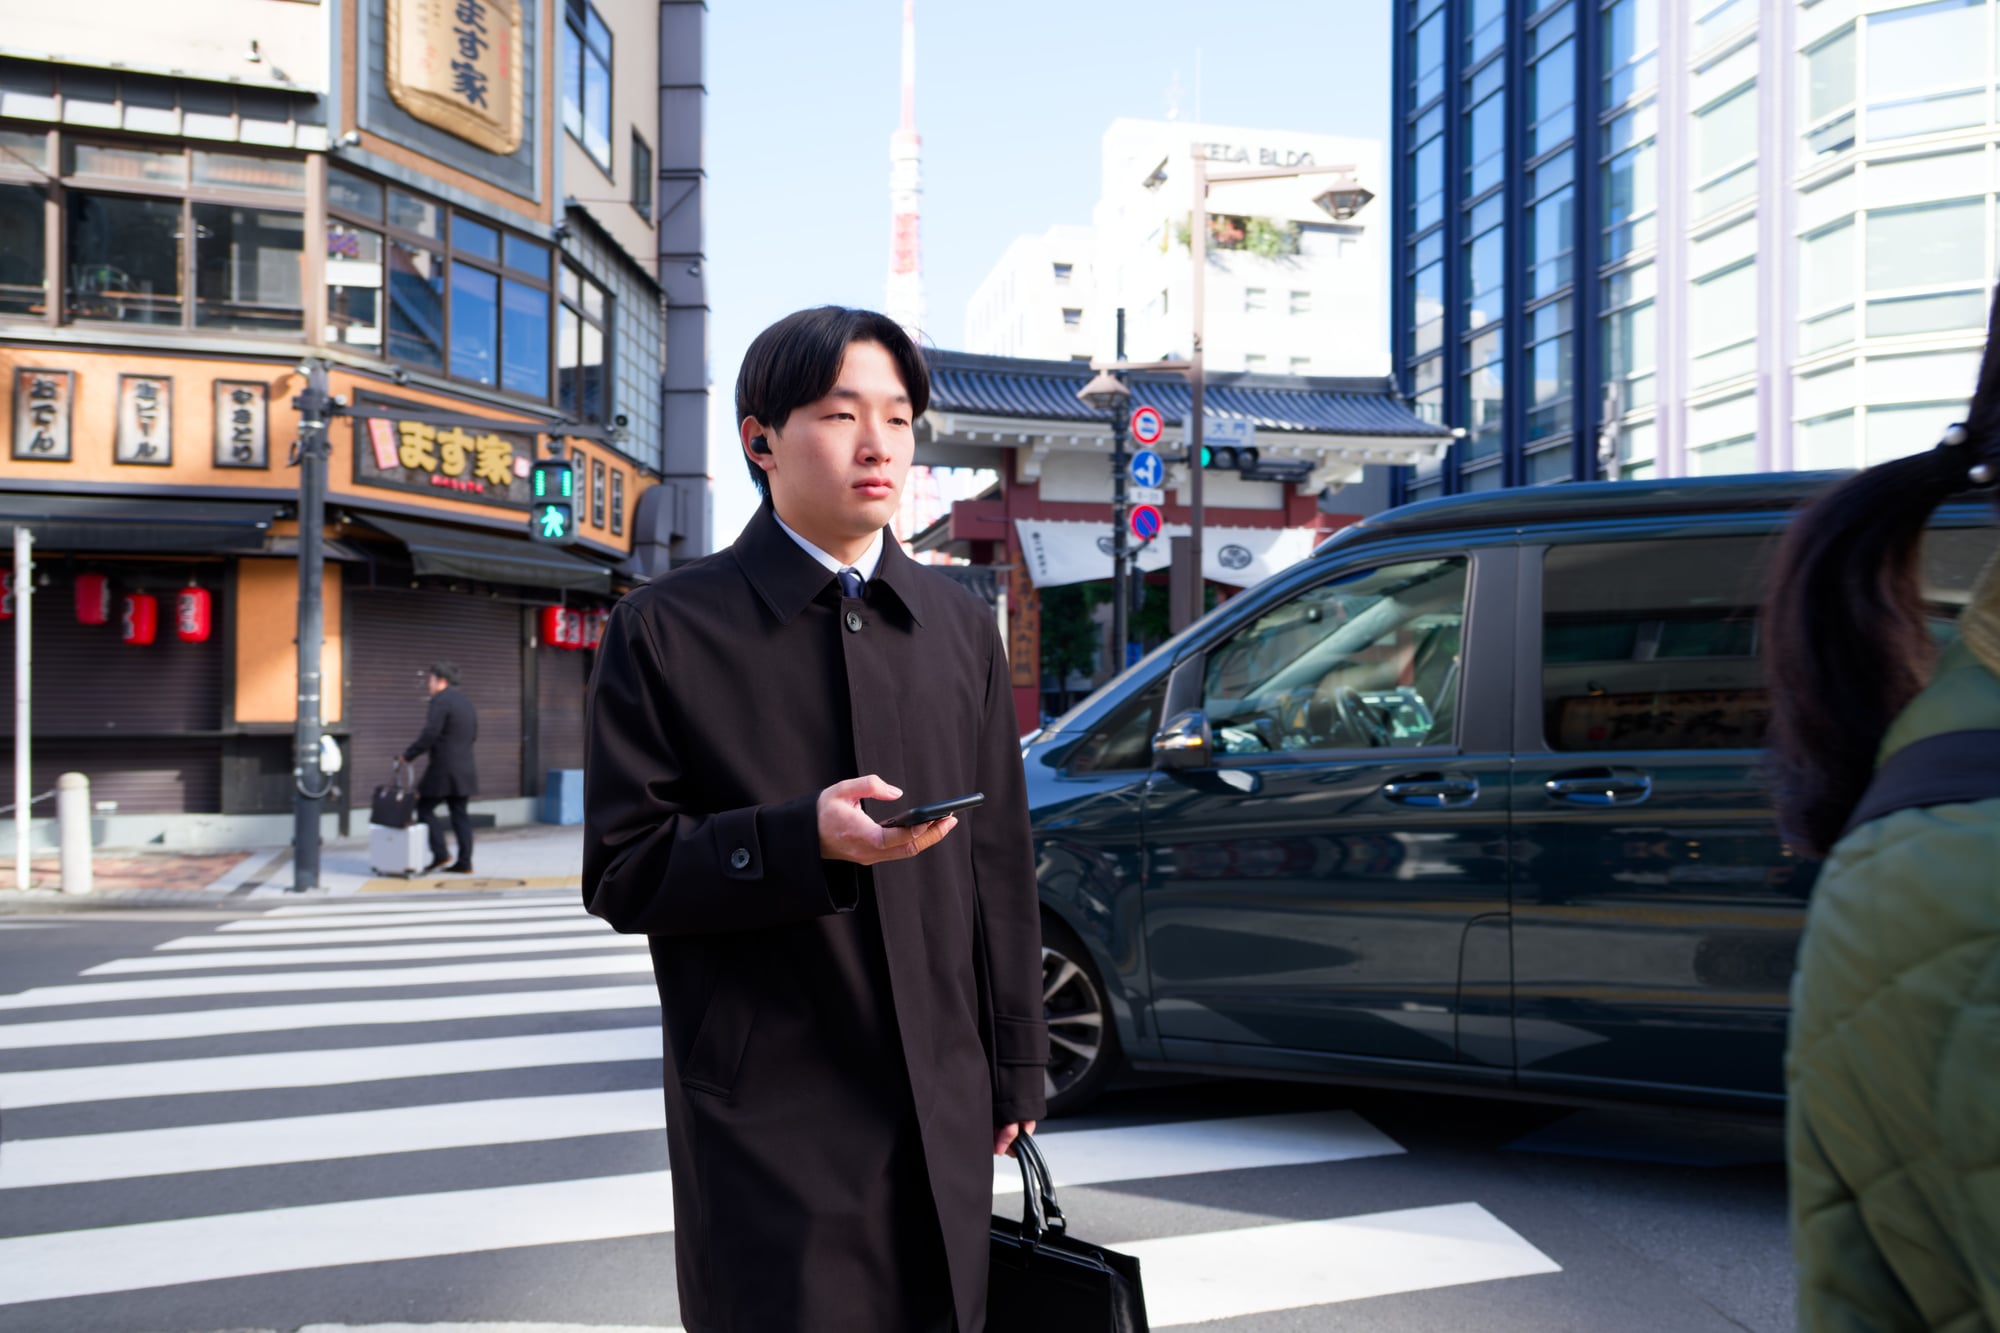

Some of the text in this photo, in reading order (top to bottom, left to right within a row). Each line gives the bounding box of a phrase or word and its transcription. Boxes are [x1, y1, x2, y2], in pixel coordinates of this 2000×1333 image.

[29, 378, 57, 453] おでん
[135, 382, 159, 460] 生ビール
[231, 388, 254, 463] やきとり
[398, 420, 513, 485] ます家
